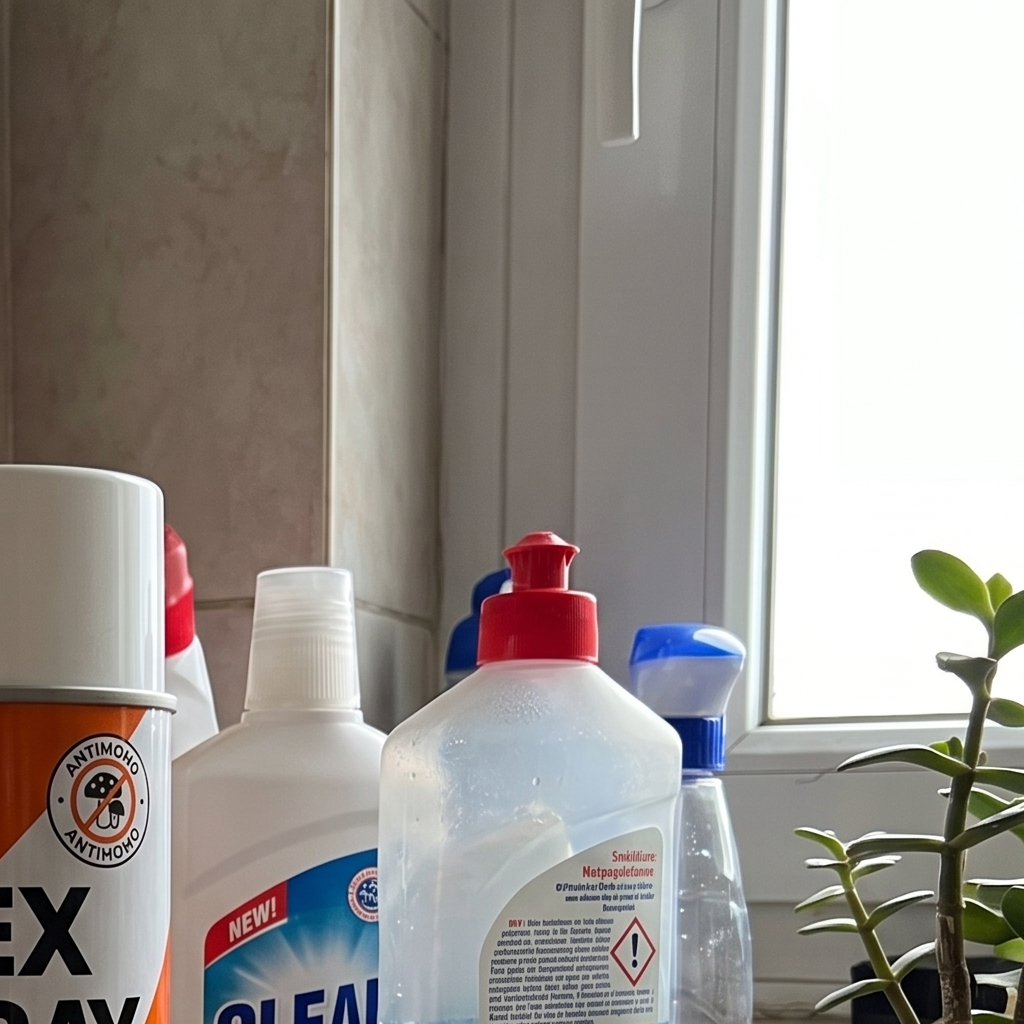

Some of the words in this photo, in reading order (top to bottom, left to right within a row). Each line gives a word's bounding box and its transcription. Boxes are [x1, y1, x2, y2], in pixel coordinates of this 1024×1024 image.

[66, 742, 139, 777] ANTIMOHO
[64, 828, 139, 861] ANTIMOHO
[228, 896, 277, 943] NEW!
